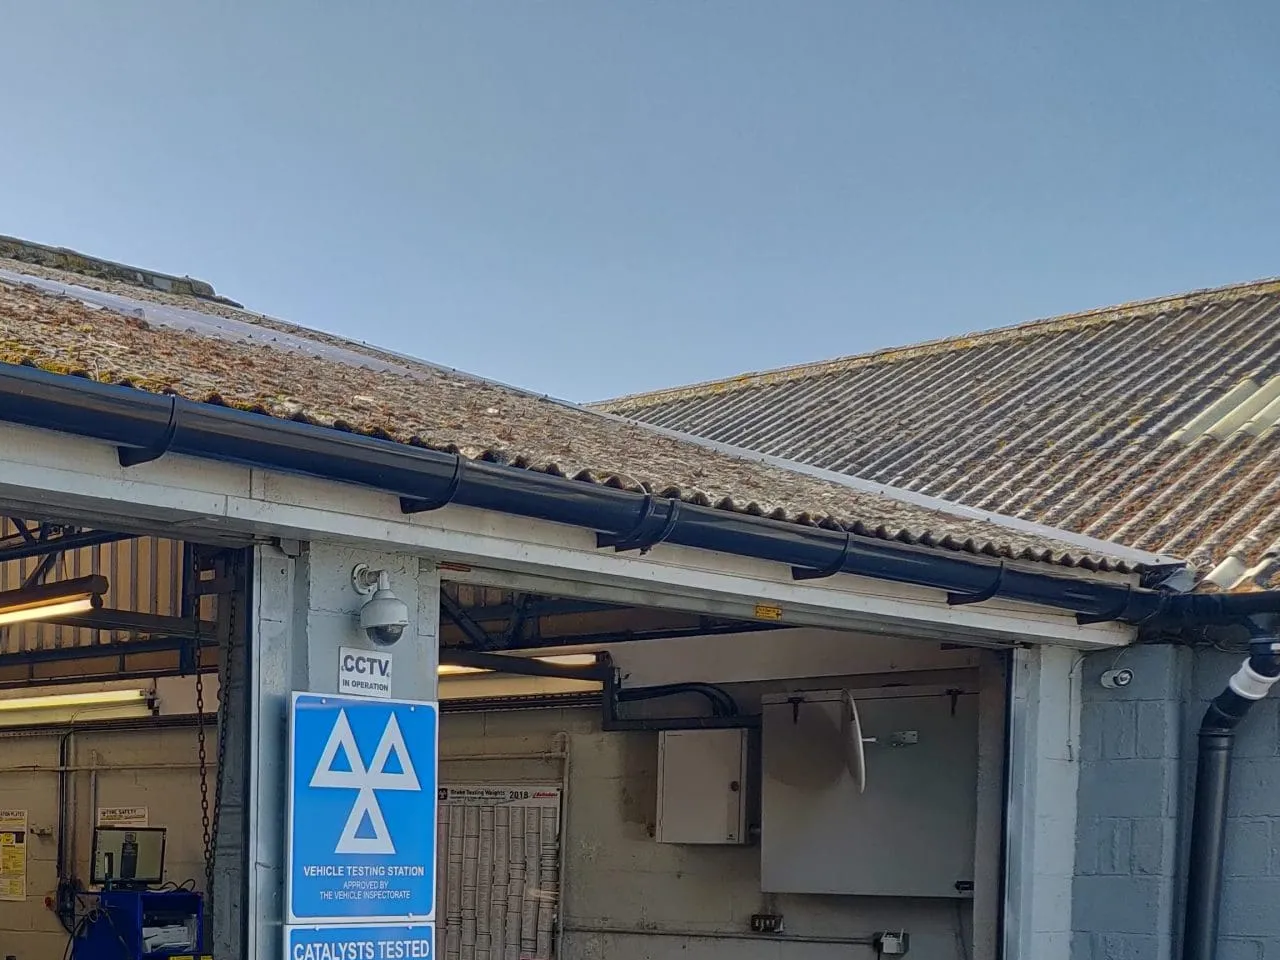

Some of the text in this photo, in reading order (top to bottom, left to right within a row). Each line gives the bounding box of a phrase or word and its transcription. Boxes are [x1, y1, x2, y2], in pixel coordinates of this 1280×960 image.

[343, 654, 389, 677] CCTV
[342, 680, 389, 691] IN OPERATION
[304, 866, 424, 877] VEHICLE TESTING STATION
[343, 881, 389, 890] APPROVED BY
[320, 890, 410, 900] THE VEHICLE INSPECTORATE
[377, 940, 430, 959] TESTED
